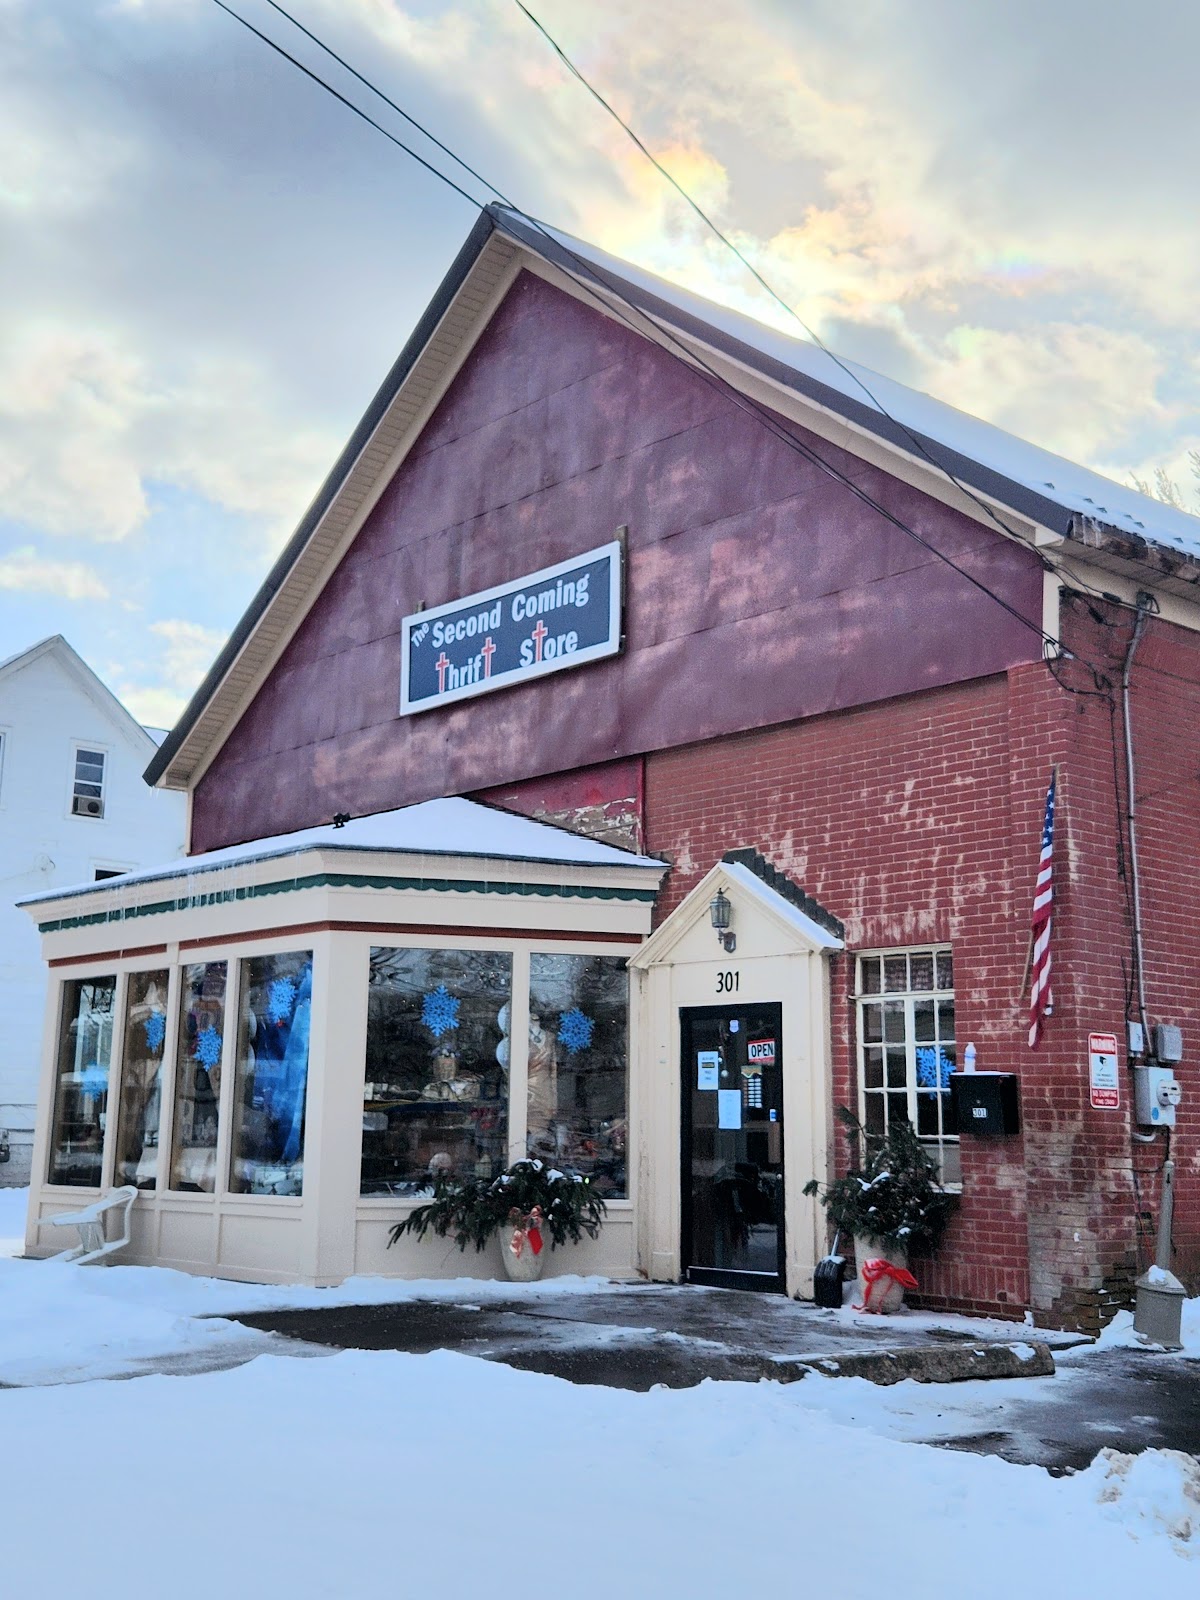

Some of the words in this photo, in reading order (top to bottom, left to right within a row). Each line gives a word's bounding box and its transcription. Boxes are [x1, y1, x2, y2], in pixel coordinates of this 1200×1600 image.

[411, 622, 430, 647] The
[432, 601, 502, 648] Second
[512, 573, 590, 622] Coming
[716, 971, 739, 993] 301
[751, 1043, 774, 1058] OPEN
[973, 1108, 986, 1117] 301
